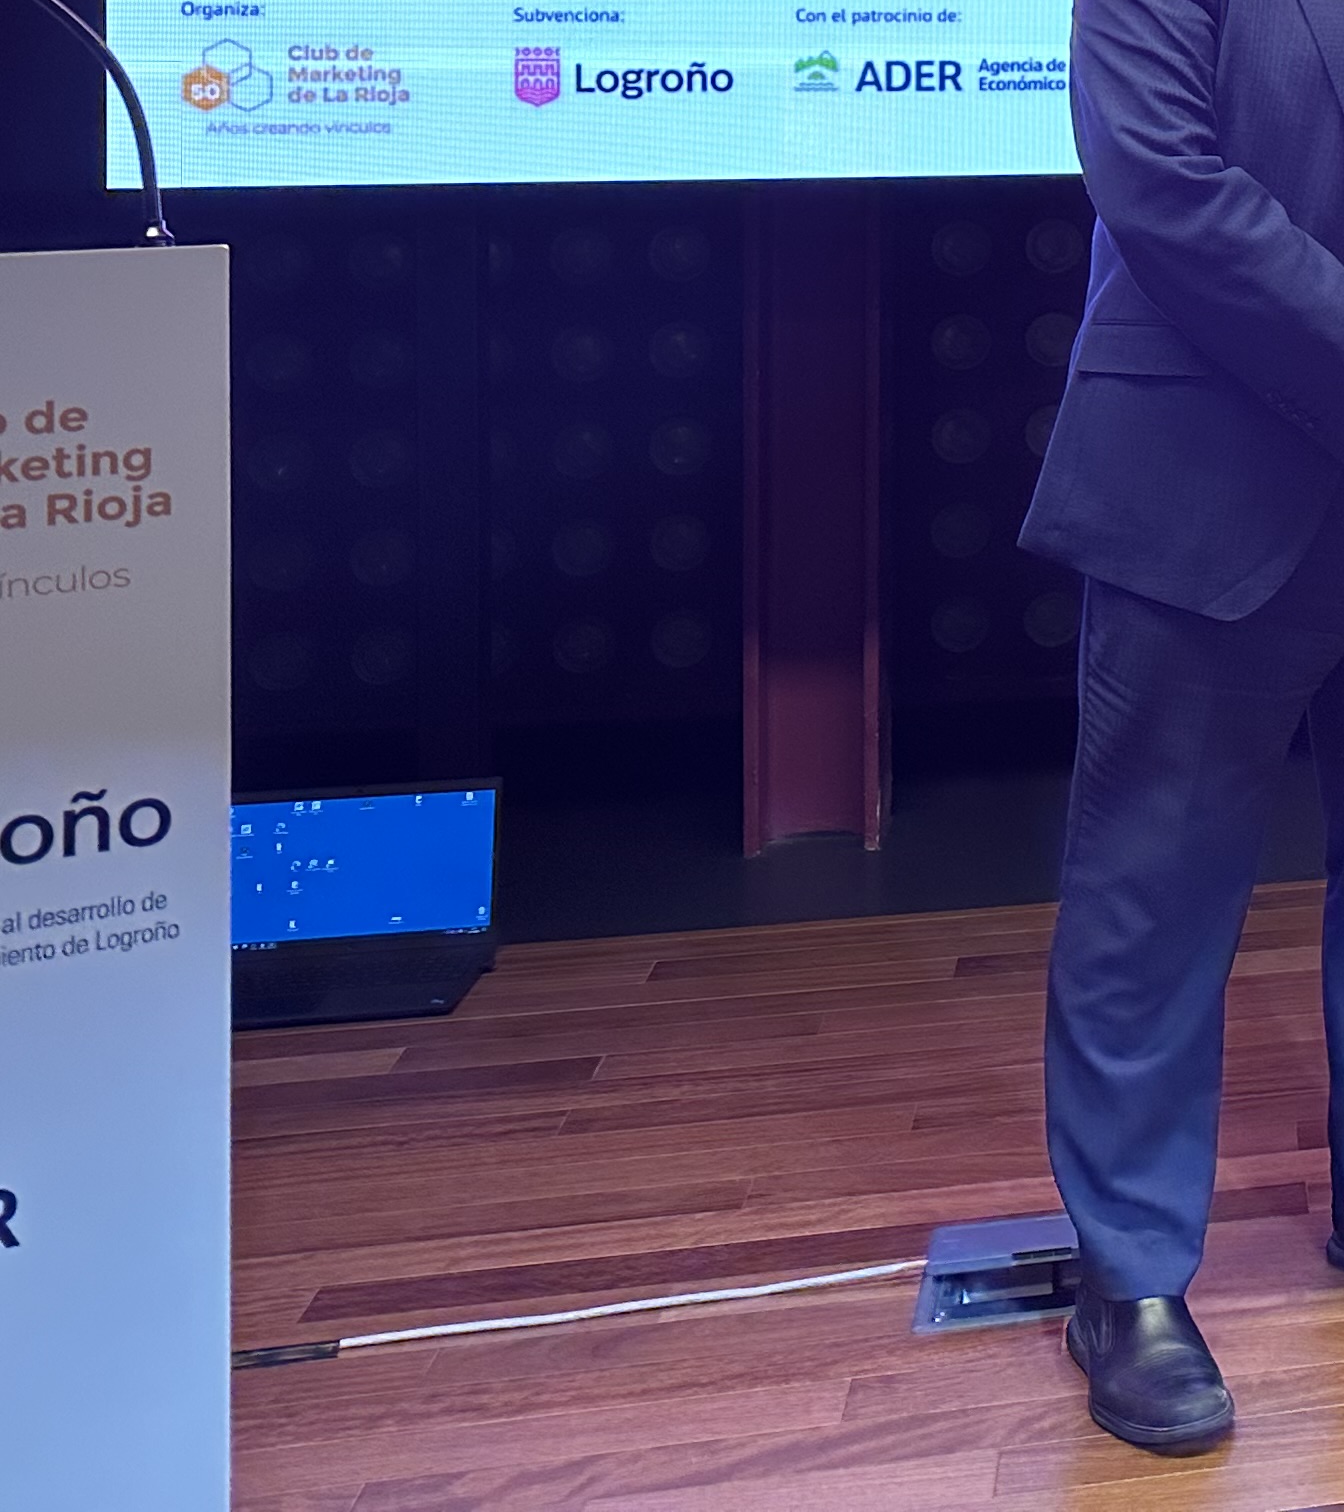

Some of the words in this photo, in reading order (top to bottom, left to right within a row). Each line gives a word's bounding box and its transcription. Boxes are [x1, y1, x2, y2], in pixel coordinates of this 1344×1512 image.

[180, 1, 265, 19] Organiza:
[513, 7, 625, 23] Subvenciona:
[796, 8, 826, 23] Con
[832, 8, 846, 23] el
[851, 8, 932, 25] patrocinio
[937, 8, 962, 23] de:
[288, 44, 339, 61] Club
[288, 65, 401, 85] Marketing
[855, 59, 963, 92] ADER
[978, 58, 1040, 74] Agencia
[1045, 59, 1066, 73] de
[576, 62, 734, 99] Logroño
[979, 76, 1067, 92] Económico
[25, 400, 88, 435] de
[47, 485, 172, 527] Rioja
[28, 896, 135, 930] desarrollo
[141, 891, 168, 912] de
[61, 935, 89, 957] de
[96, 921, 180, 952] Logroño
